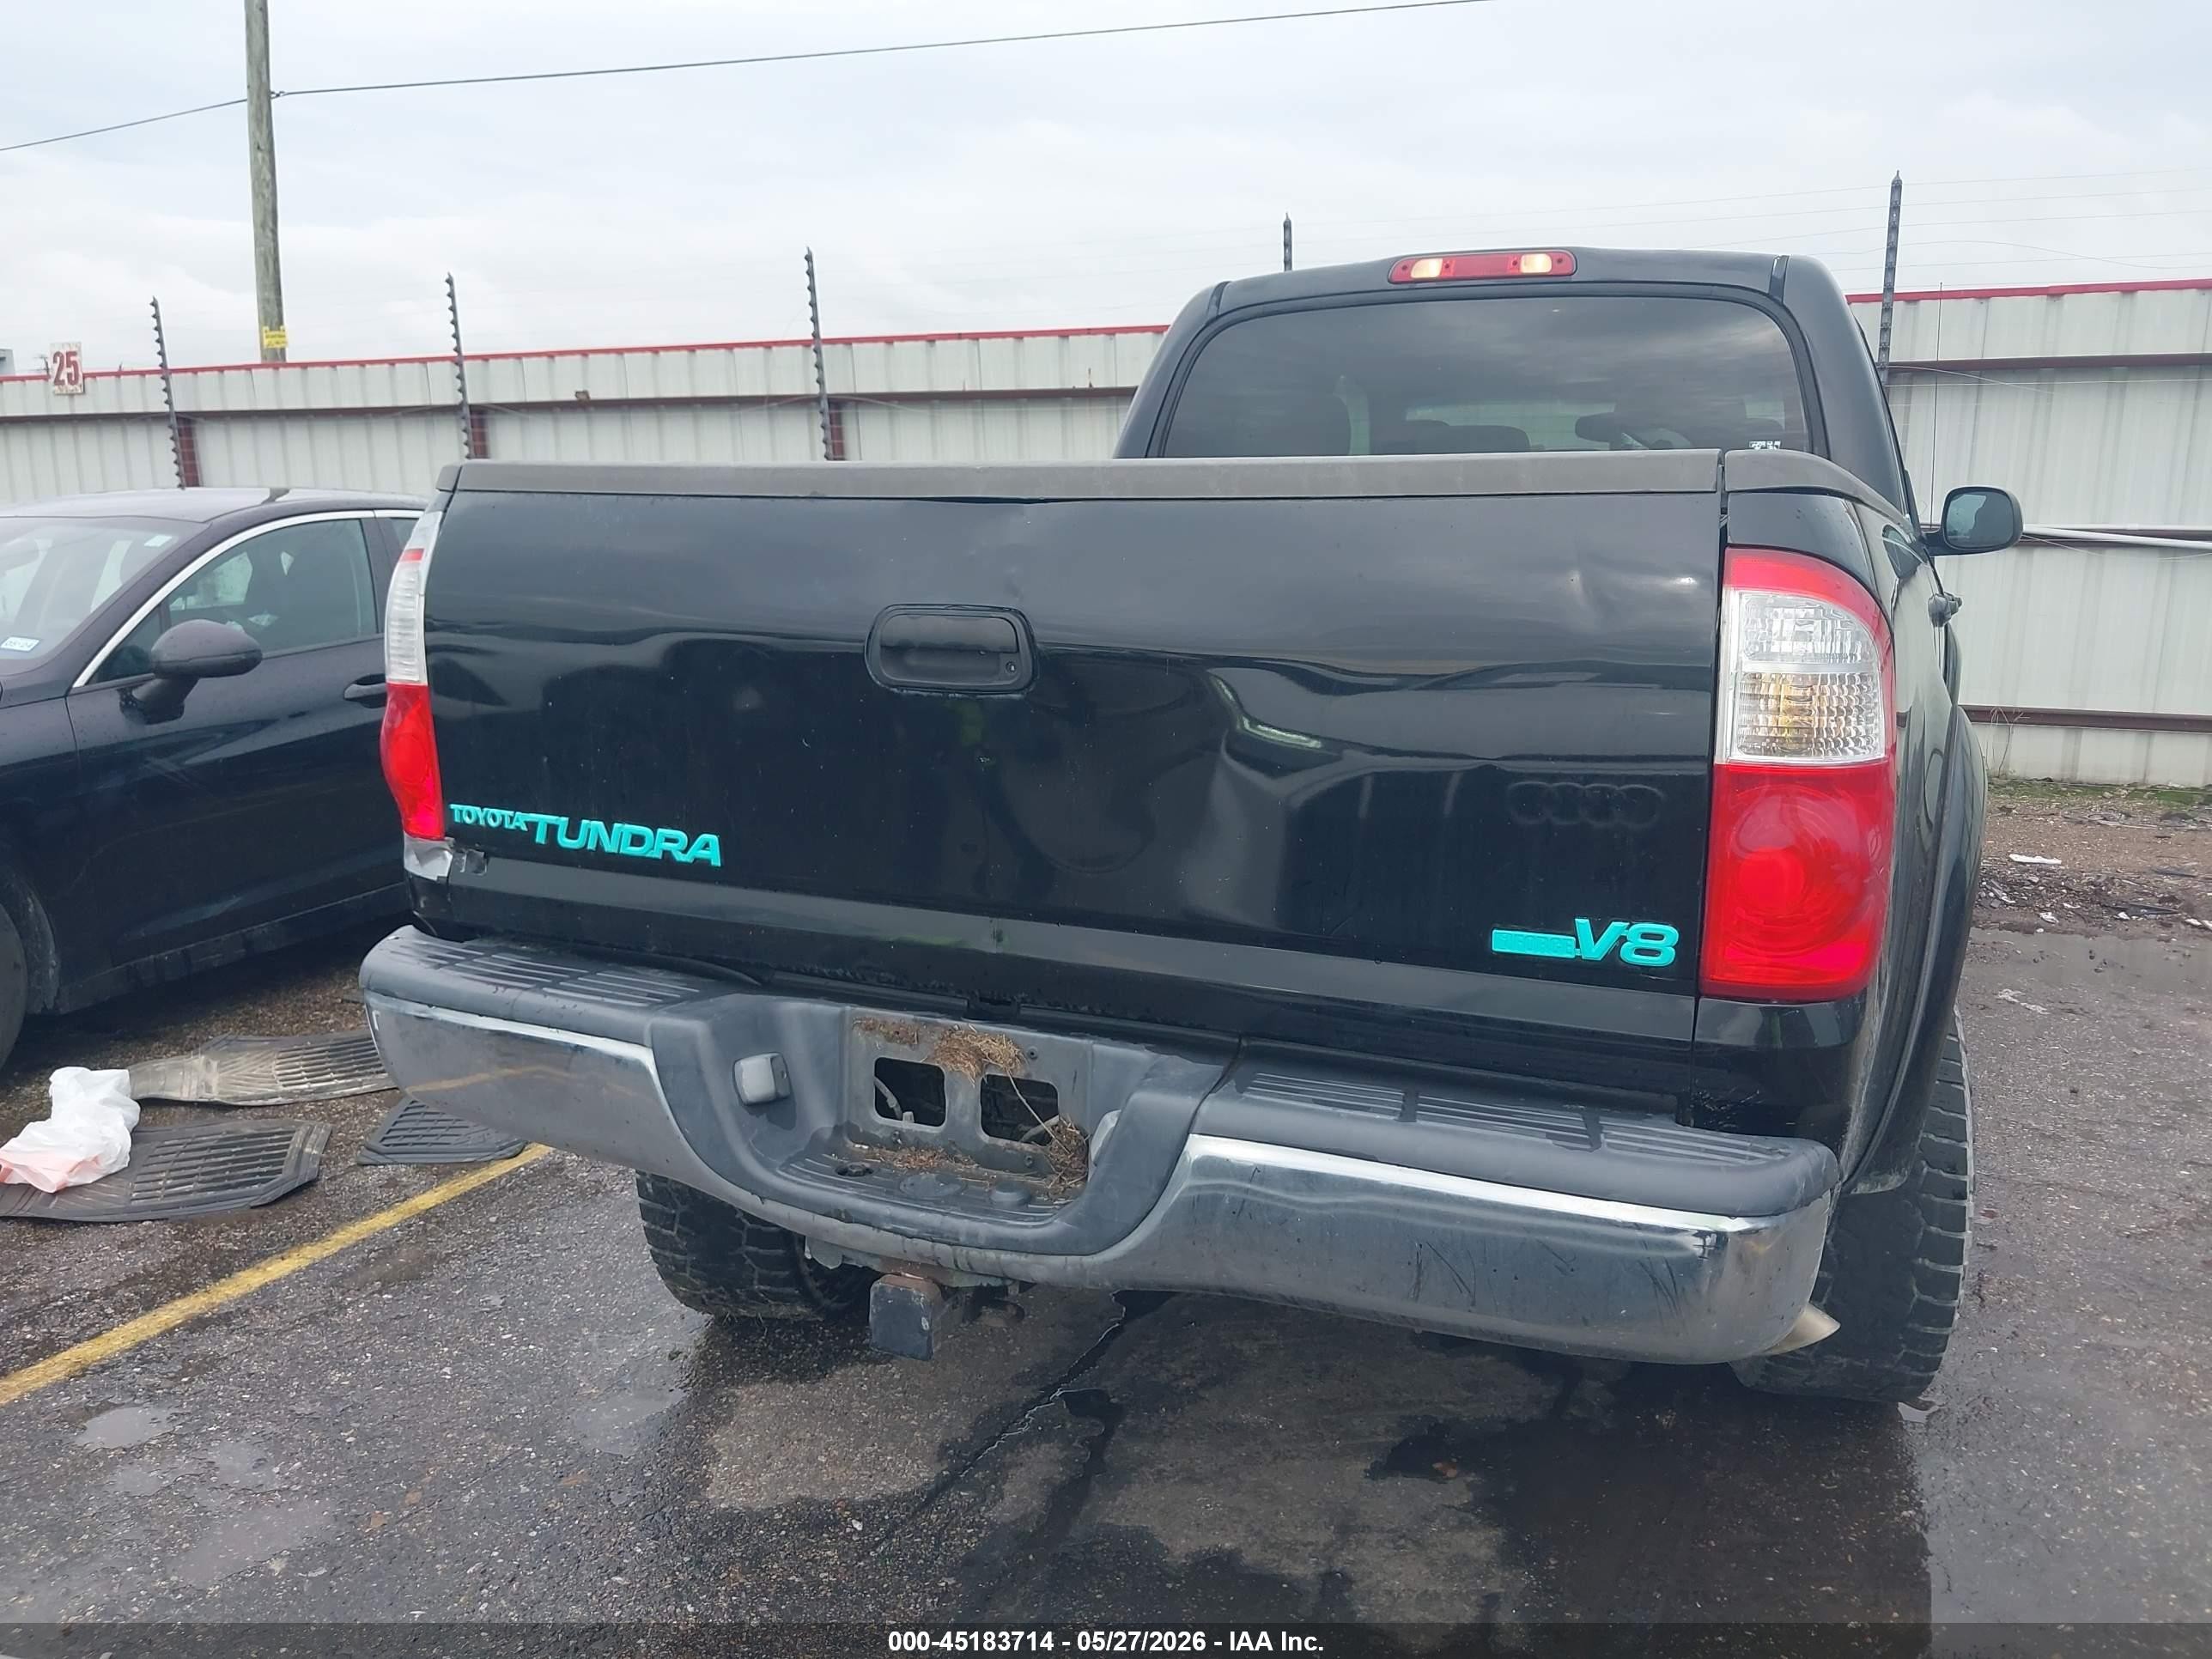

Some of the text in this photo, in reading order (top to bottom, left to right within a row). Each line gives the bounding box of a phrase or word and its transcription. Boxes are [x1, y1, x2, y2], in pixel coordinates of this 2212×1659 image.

[52, 350, 79, 386] 25
[449, 804, 722, 867] TOYOTA TUNDRA
[1574, 918, 1680, 967] V8
